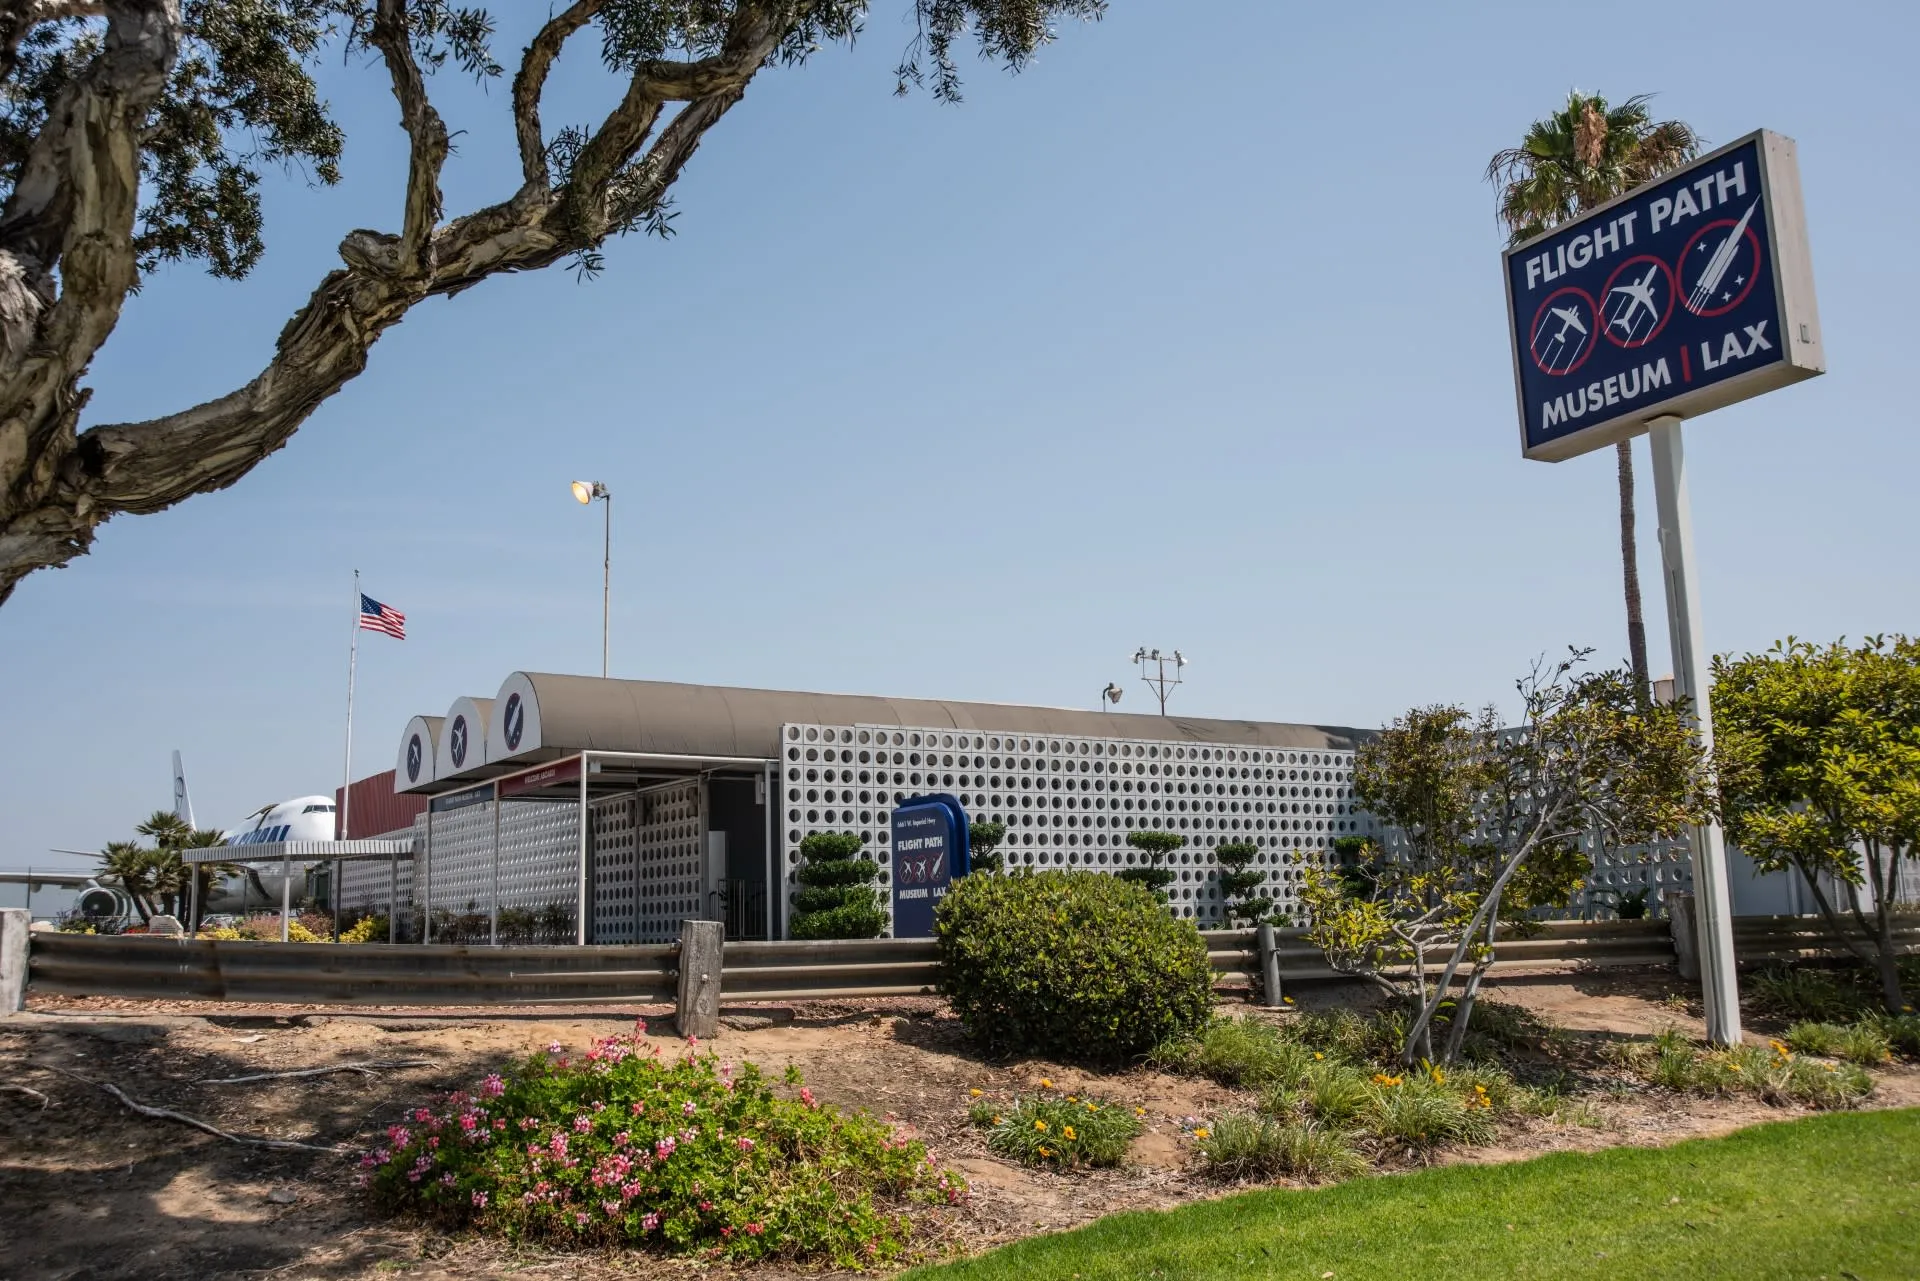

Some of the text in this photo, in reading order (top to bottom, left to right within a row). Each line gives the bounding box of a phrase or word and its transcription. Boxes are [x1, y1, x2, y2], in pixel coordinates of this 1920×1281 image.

[1525, 161, 1747, 290] FLIGHT PATH
[1542, 320, 1773, 430] MUSEUM LAX
[897, 836, 943, 851] FLIGHT PATH
[899, 886, 946, 900] MUSEUM LAX
